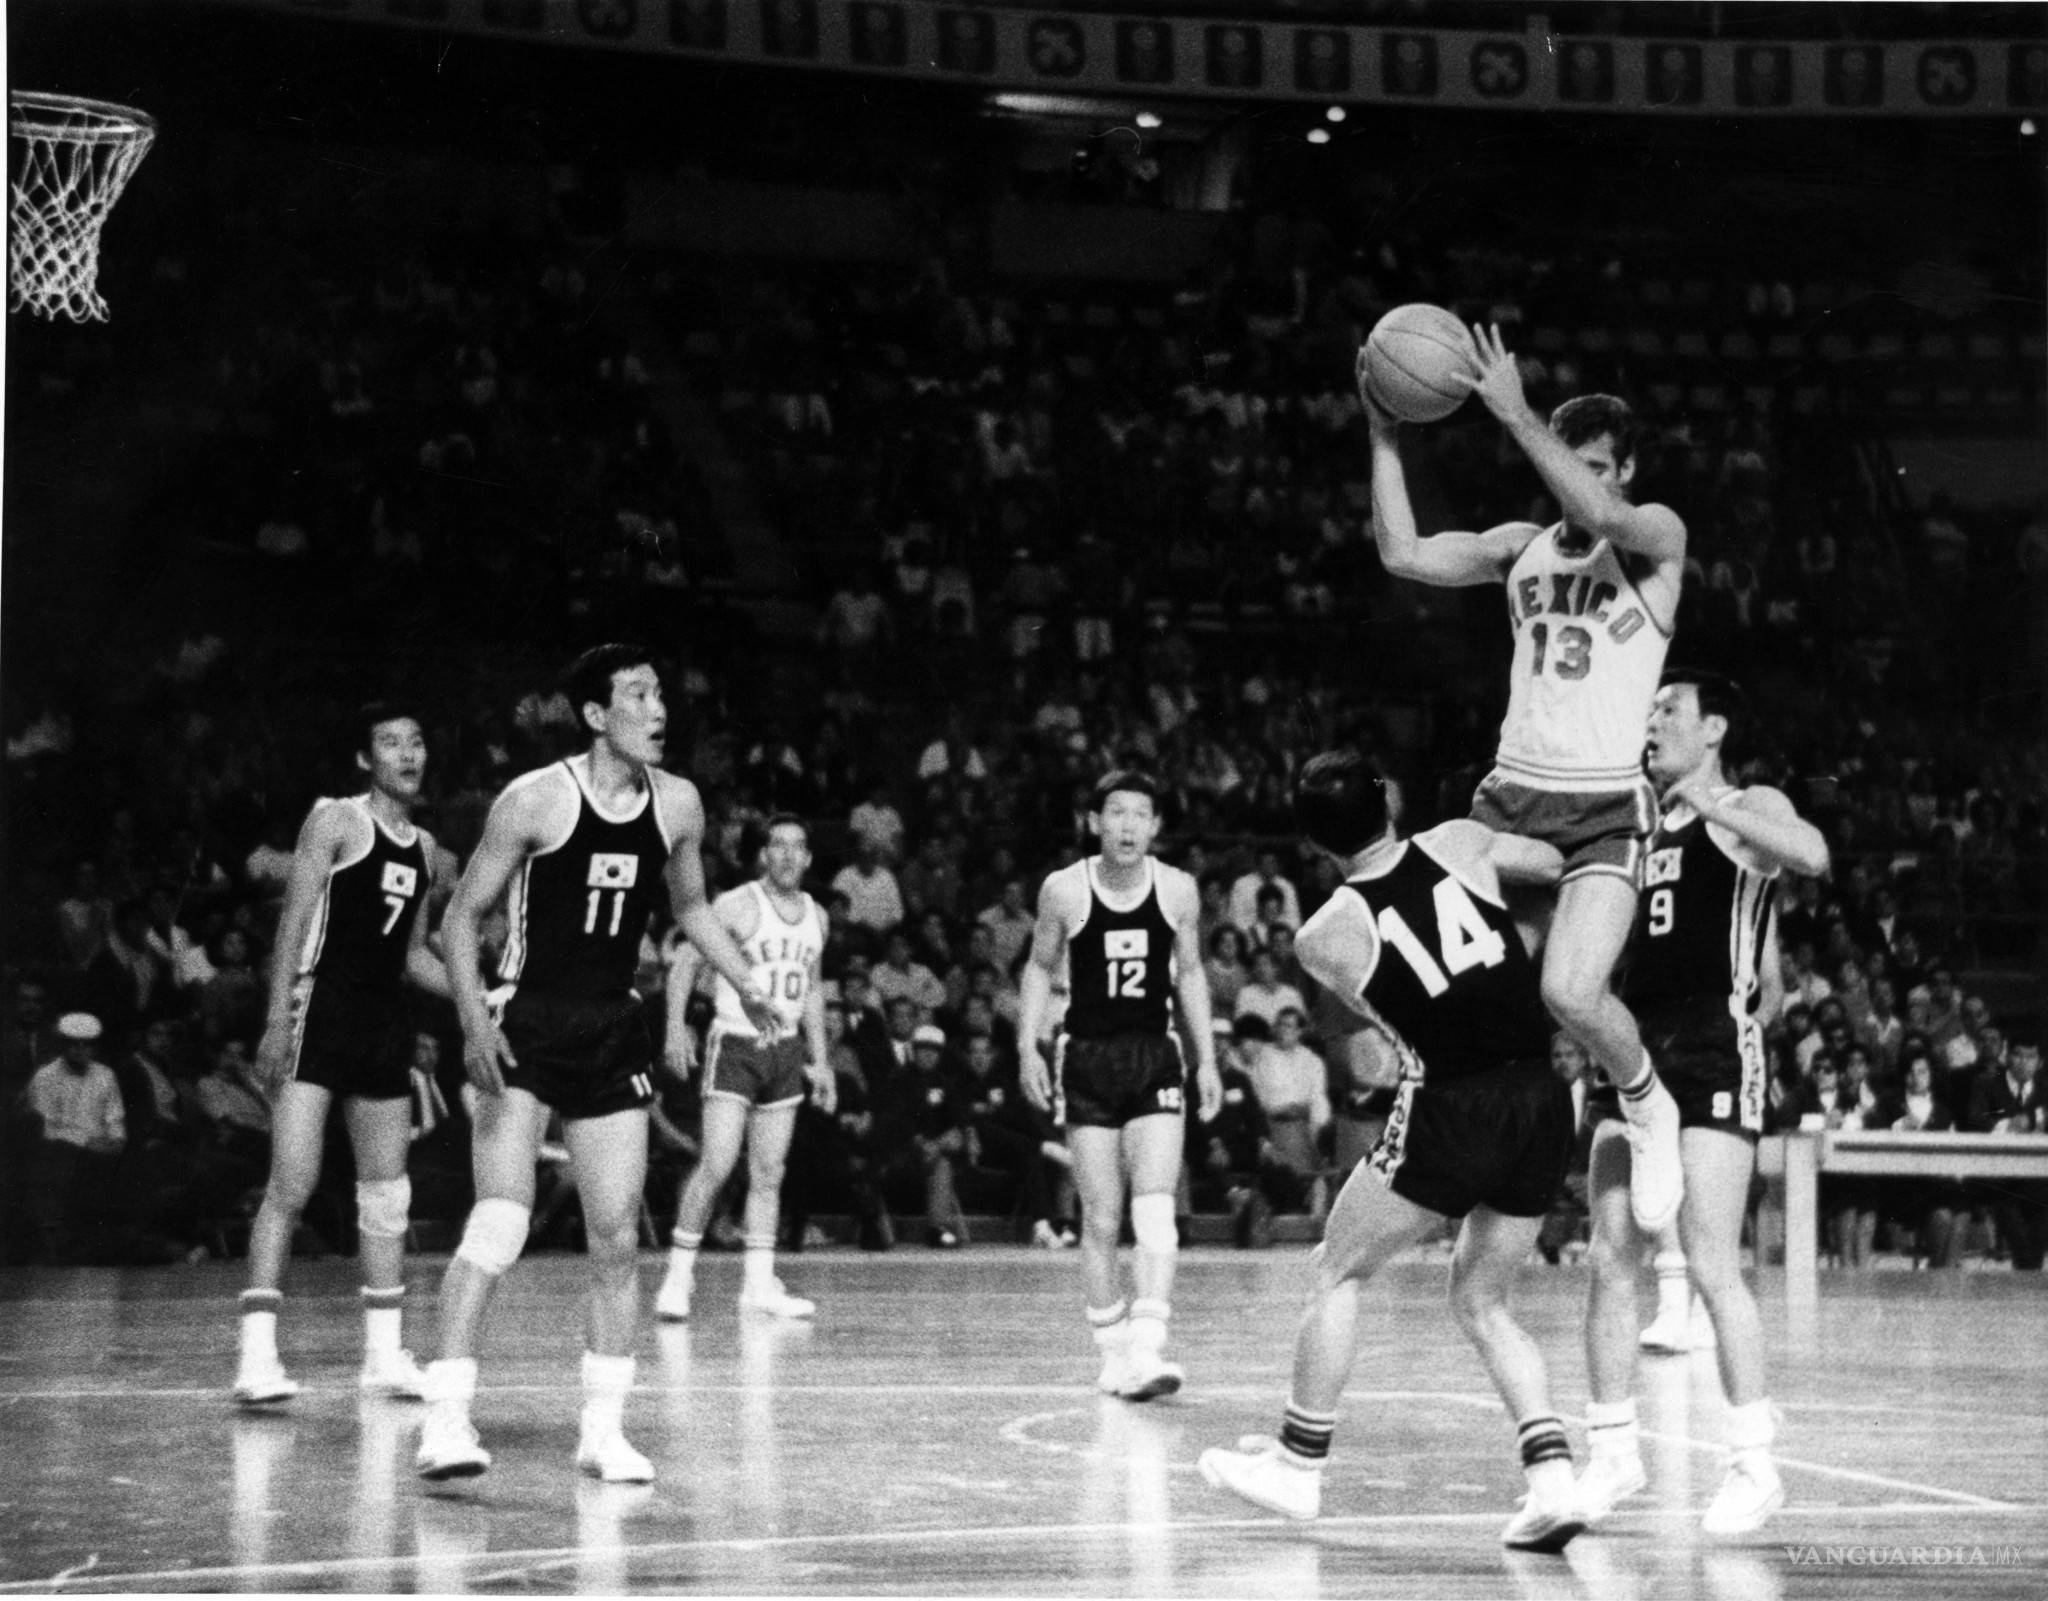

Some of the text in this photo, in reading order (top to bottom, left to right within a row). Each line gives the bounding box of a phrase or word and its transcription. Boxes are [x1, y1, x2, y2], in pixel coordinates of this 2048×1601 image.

[1531, 622, 1592, 680] 13
[383, 894, 405, 935] 7
[584, 888, 625, 936] 11
[1649, 888, 1674, 936] 9
[1378, 874, 1506, 998] 14
[769, 970, 802, 1000] 10
[1107, 960, 1147, 998] 12
[631, 1072, 652, 1098] 11
